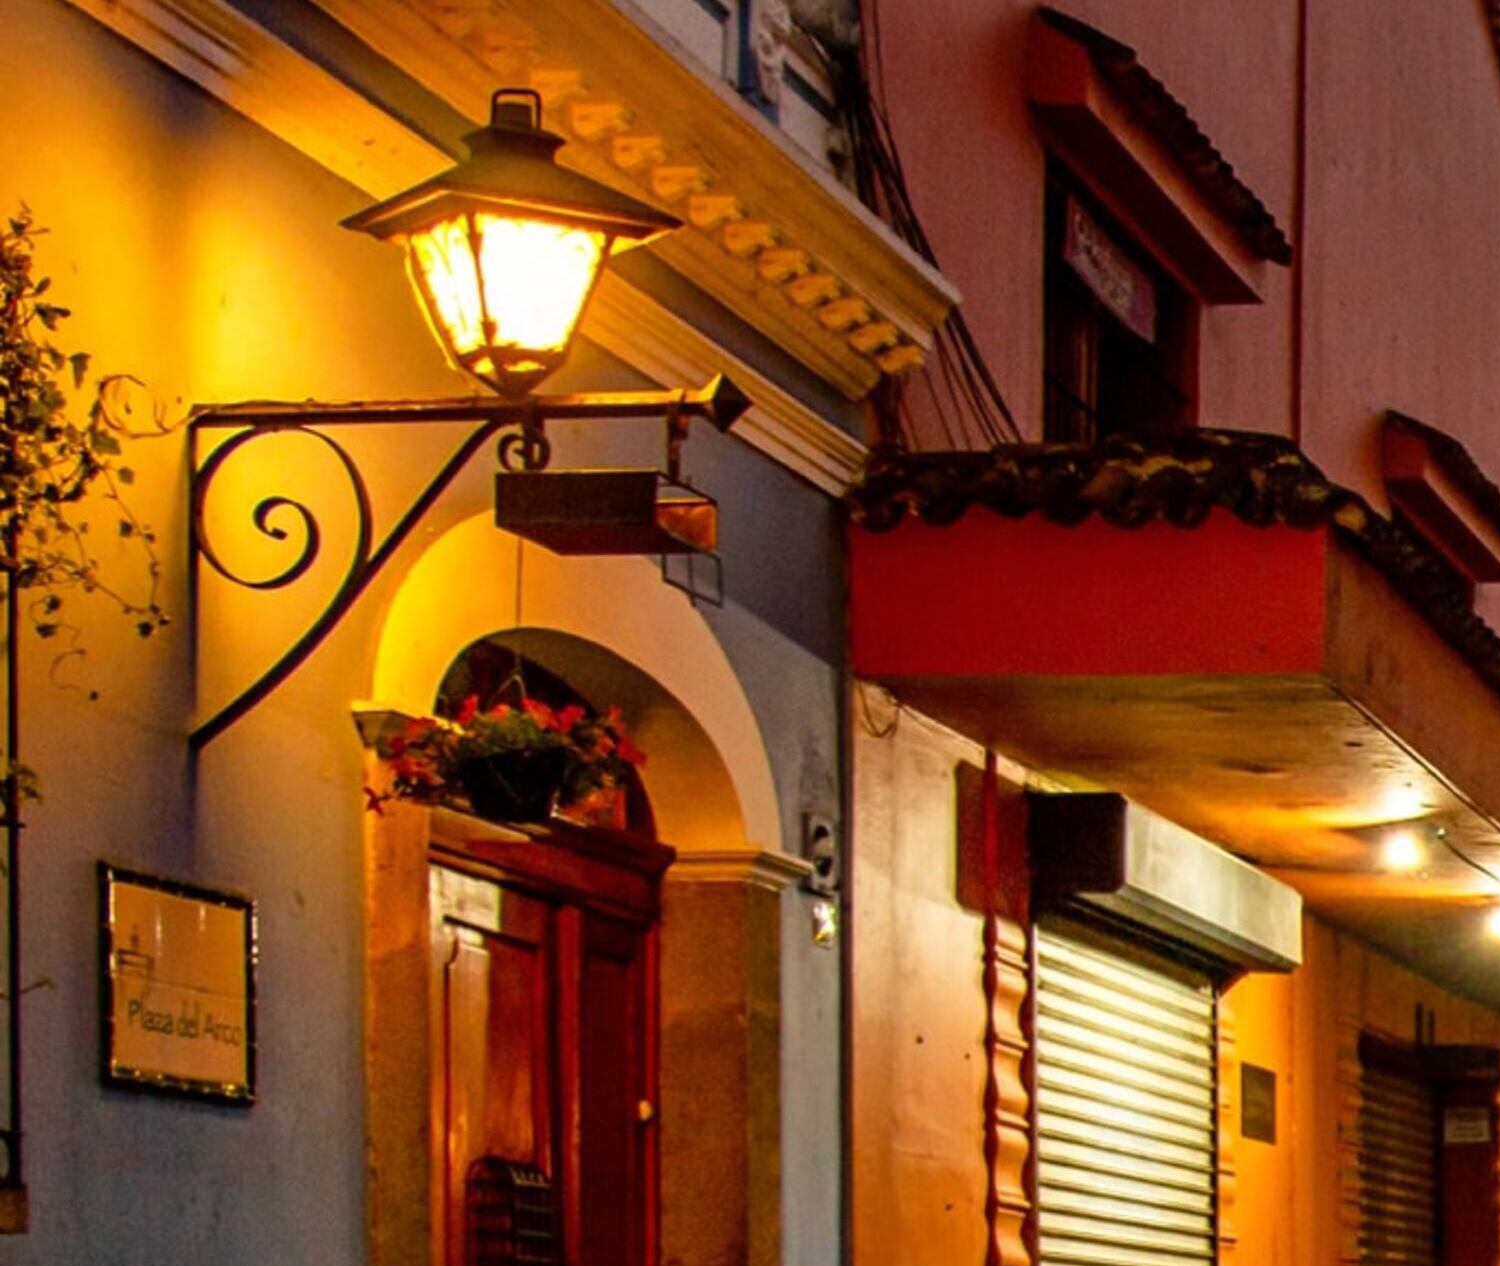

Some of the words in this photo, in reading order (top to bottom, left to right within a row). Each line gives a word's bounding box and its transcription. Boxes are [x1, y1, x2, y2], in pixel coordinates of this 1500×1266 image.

[128, 998, 173, 1035] Plaza
[176, 999, 199, 1039] del
[204, 1012, 241, 1047] Arco
